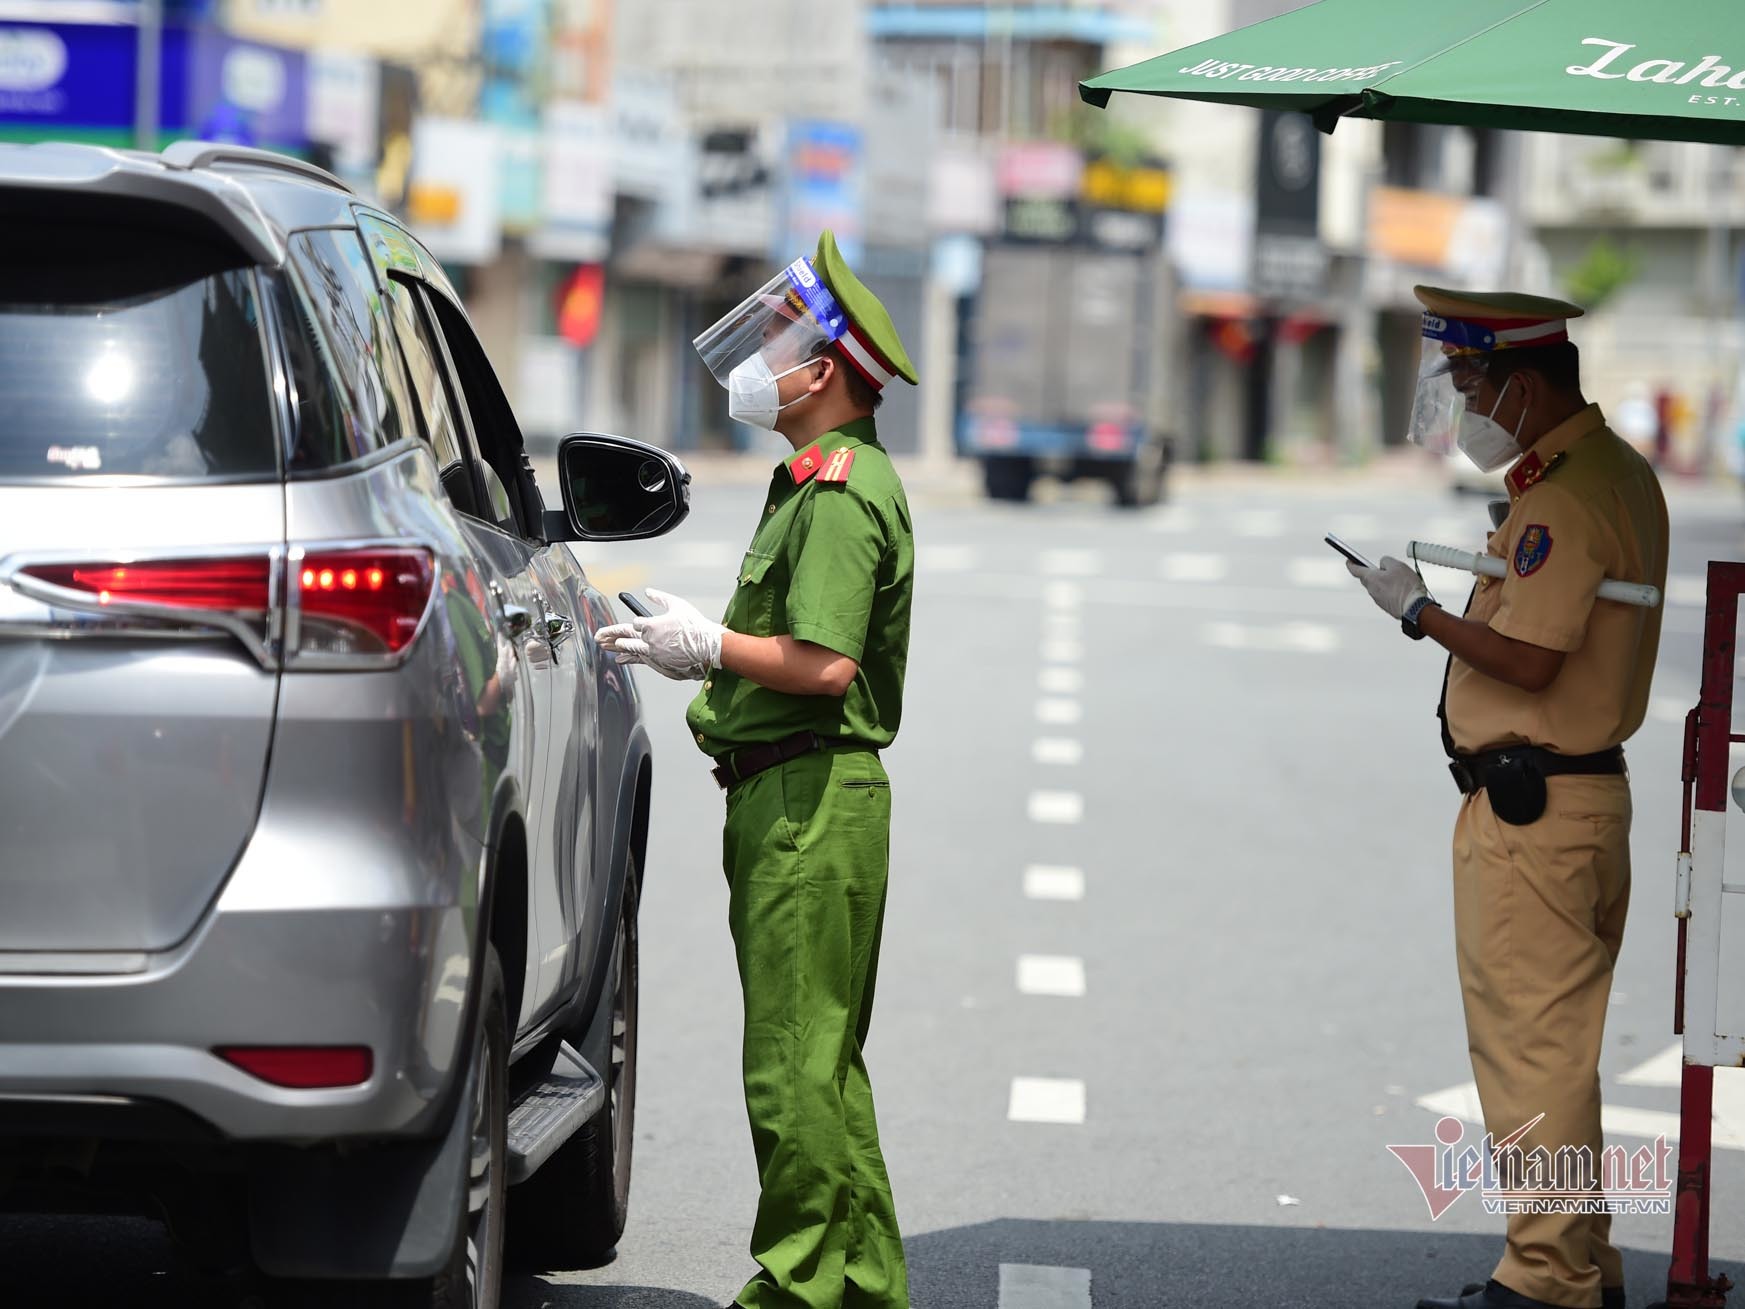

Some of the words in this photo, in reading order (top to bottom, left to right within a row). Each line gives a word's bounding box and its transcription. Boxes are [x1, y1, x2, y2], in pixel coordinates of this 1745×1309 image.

[1178, 58, 1254, 79] JUST
[1238, 67, 1316, 81] GOOD
[1688, 94, 1741, 107] EST.
